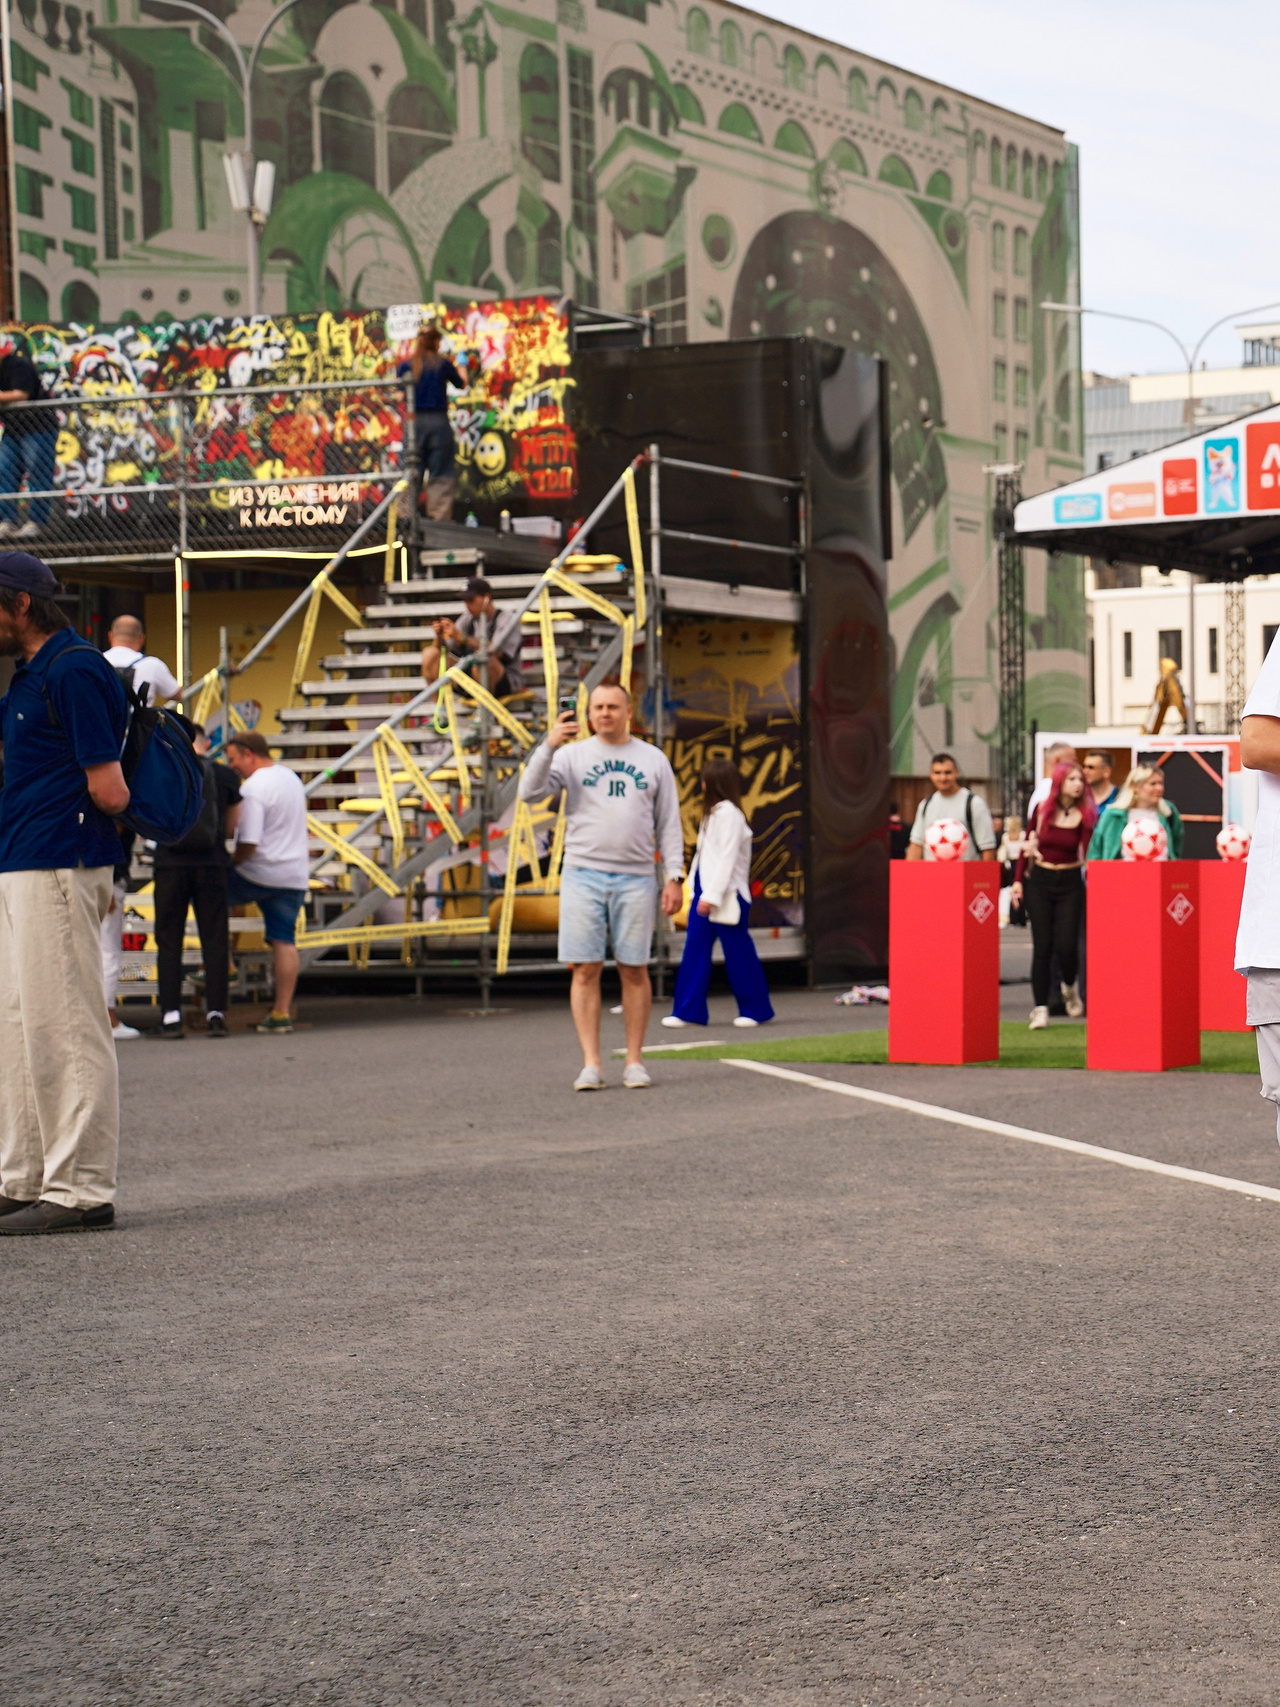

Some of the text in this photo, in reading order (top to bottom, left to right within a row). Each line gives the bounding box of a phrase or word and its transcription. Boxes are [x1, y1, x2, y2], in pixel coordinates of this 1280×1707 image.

[1260, 473, 1274, 488] В
[229, 482, 360, 507] ИЗ УВАЖЕНИЯ
[239, 504, 348, 527] К КАСТОМУ
[582, 759, 648, 791] RICHMOND
[608, 779, 626, 797] JR
